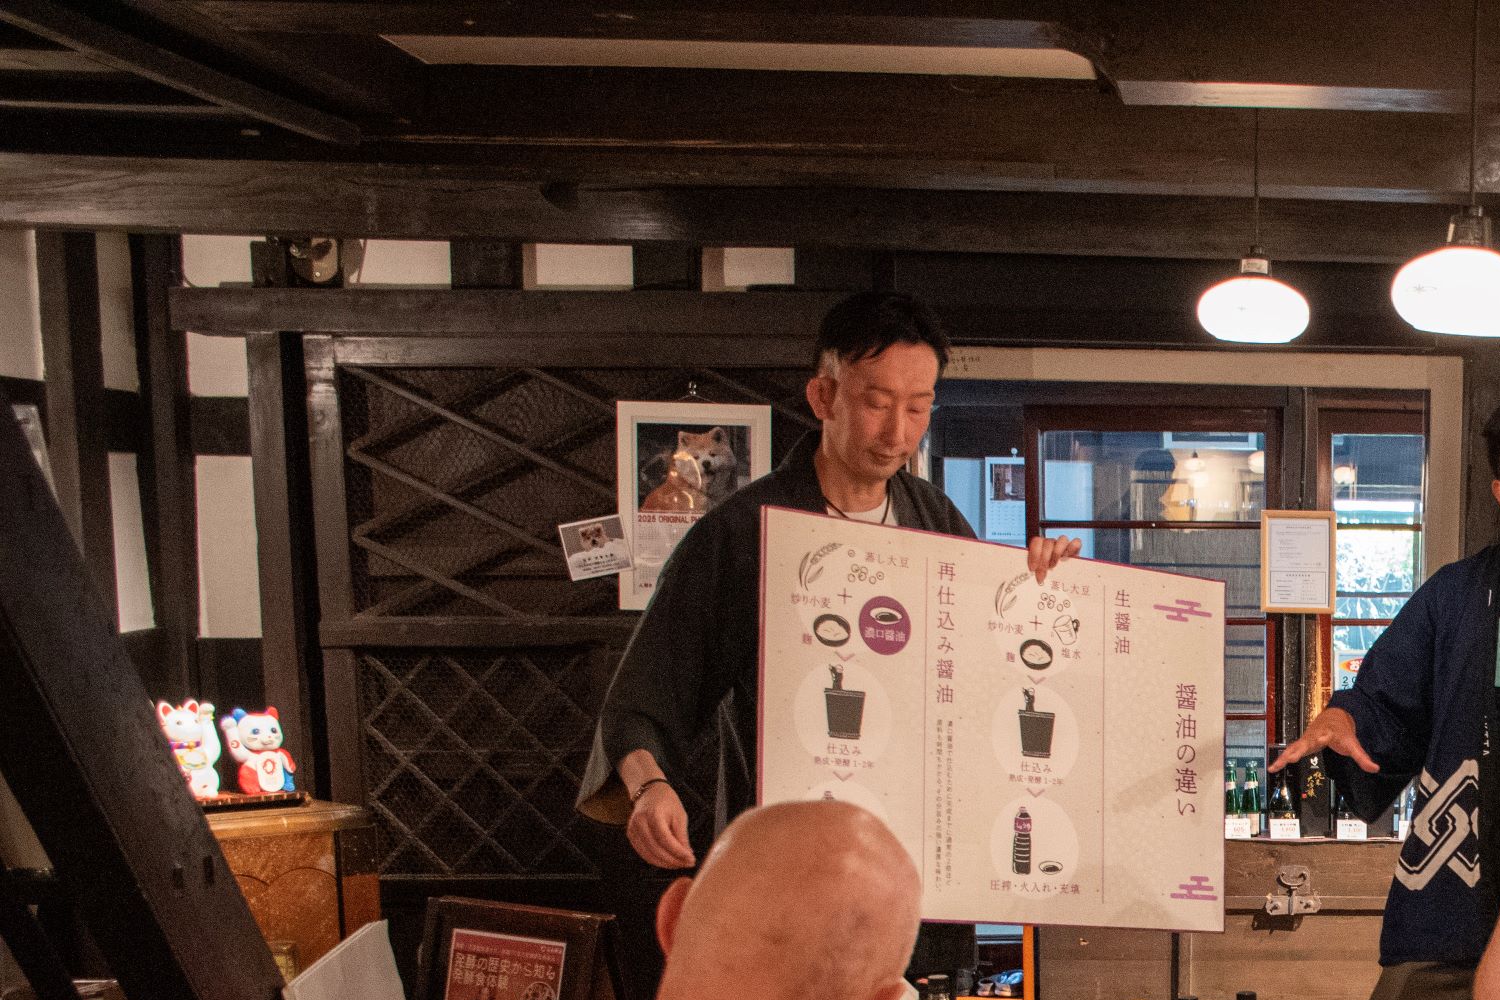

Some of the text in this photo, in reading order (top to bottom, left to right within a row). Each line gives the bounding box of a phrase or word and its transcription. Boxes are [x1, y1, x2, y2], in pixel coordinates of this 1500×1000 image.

[658, 514, 689, 523] ORIGINAL
[937, 561, 956, 704] 再仕込み醤油
[1114, 589, 1131, 655] 生醤油
[827, 743, 862, 756] 仕込み
[1020, 761, 1053, 774] 仕込み
[1175, 683, 1198, 816] 醤油の違い
